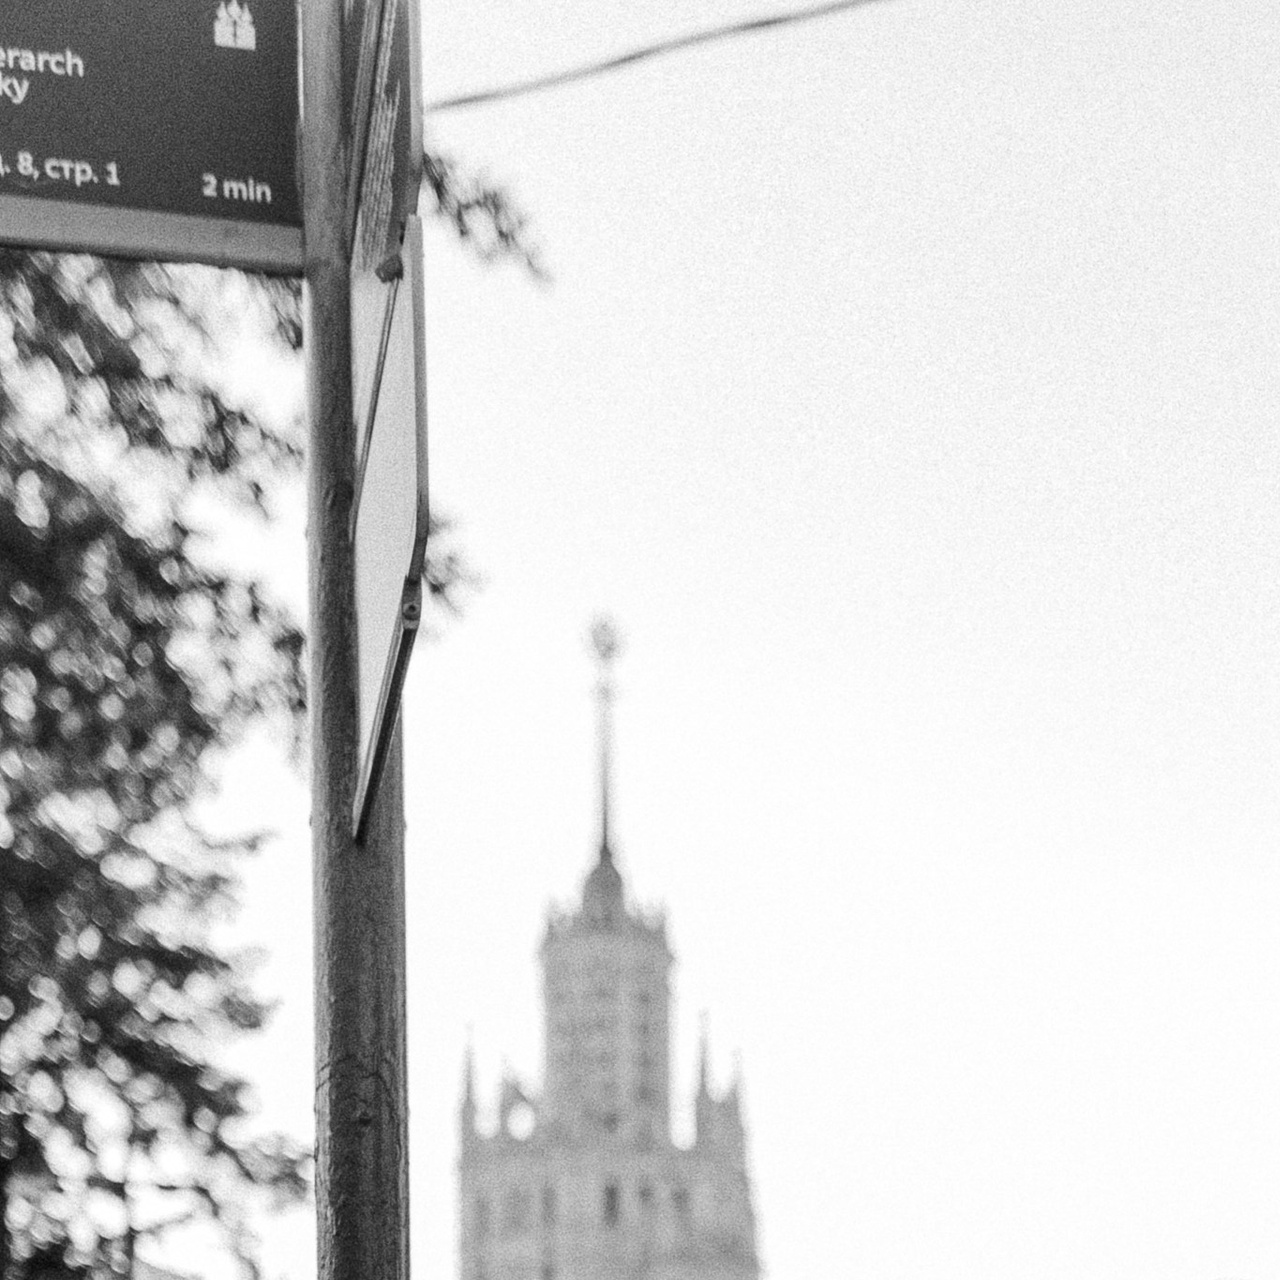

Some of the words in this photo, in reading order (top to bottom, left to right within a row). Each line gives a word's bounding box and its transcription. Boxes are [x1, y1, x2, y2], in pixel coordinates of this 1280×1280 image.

[44, 157, 99, 187] стр.
[106, 161, 120, 185] 1
[202, 173, 217, 197] 2
[223, 176, 271, 203] min
